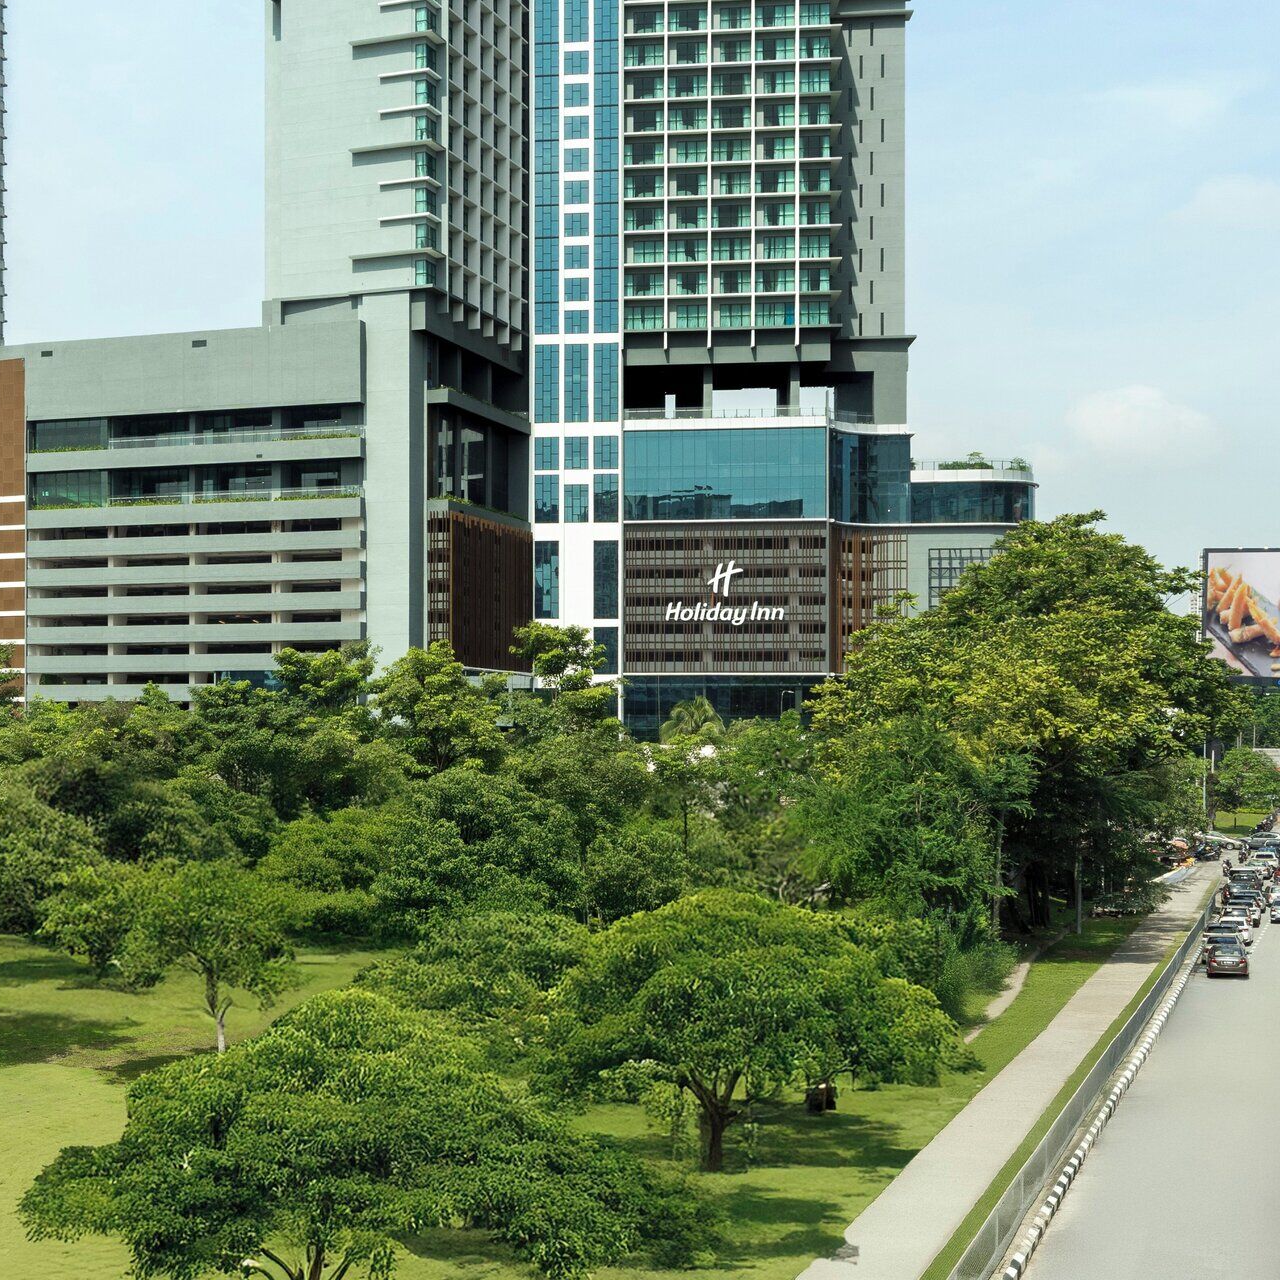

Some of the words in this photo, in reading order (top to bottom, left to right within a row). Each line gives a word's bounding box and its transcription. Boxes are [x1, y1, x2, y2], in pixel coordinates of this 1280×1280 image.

[707, 560, 744, 597] H
[665, 601, 747, 626] Holiday
[750, 600, 785, 621] Inn
